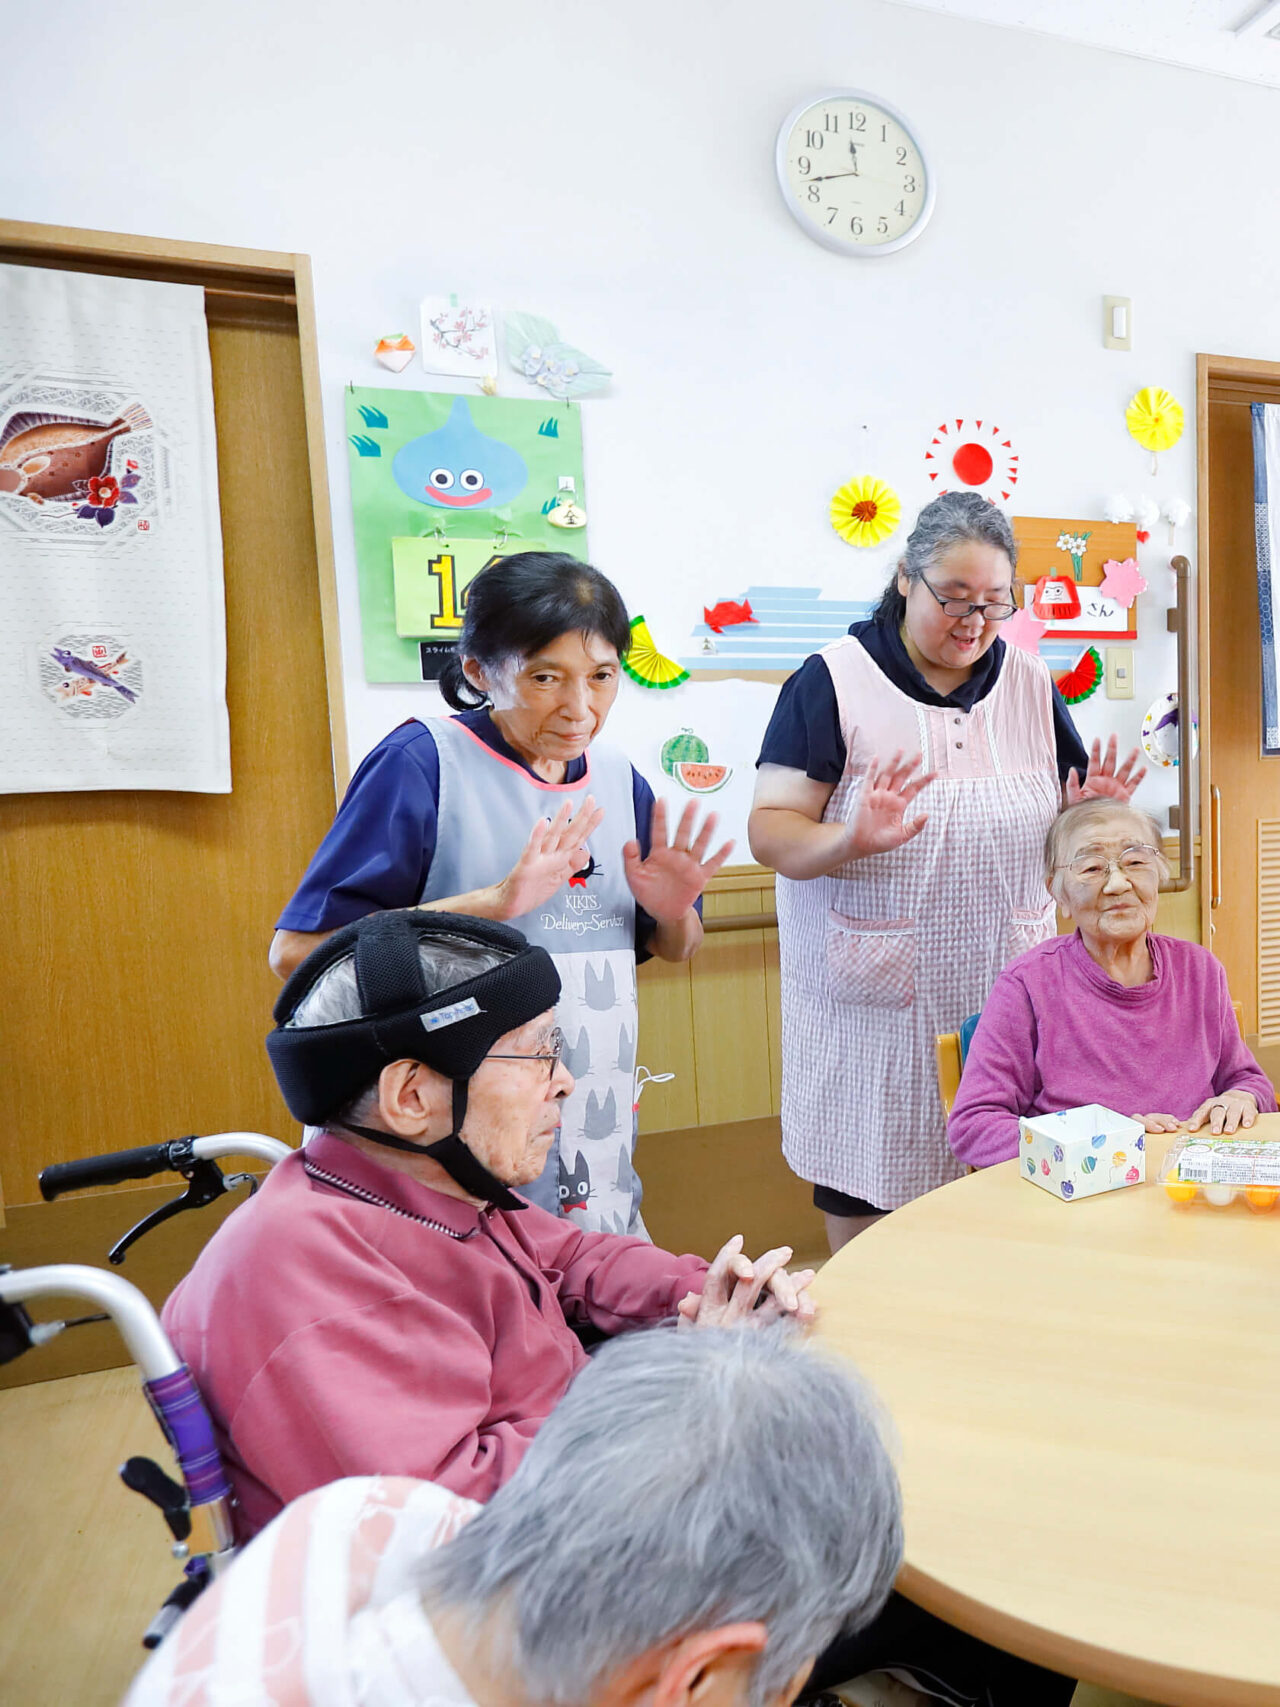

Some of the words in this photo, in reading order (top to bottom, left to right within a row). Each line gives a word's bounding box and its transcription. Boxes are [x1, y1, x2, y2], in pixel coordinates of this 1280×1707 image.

[824, 113, 840, 134] 11
[848, 111, 867, 133] 12
[805, 129, 824, 151] 10
[881, 124, 887, 142] 1
[798, 156, 811, 175] 9
[895, 147, 907, 166] 2
[807, 184, 821, 203] 8
[903, 175, 916, 193] 3
[826, 207, 839, 225] 7
[894, 200, 906, 217] 4
[850, 216, 863, 235] 6
[876, 216, 889, 234] 5
[1086, 602, 1114, 618] さん
[540, 913, 587, 937] Delivery
